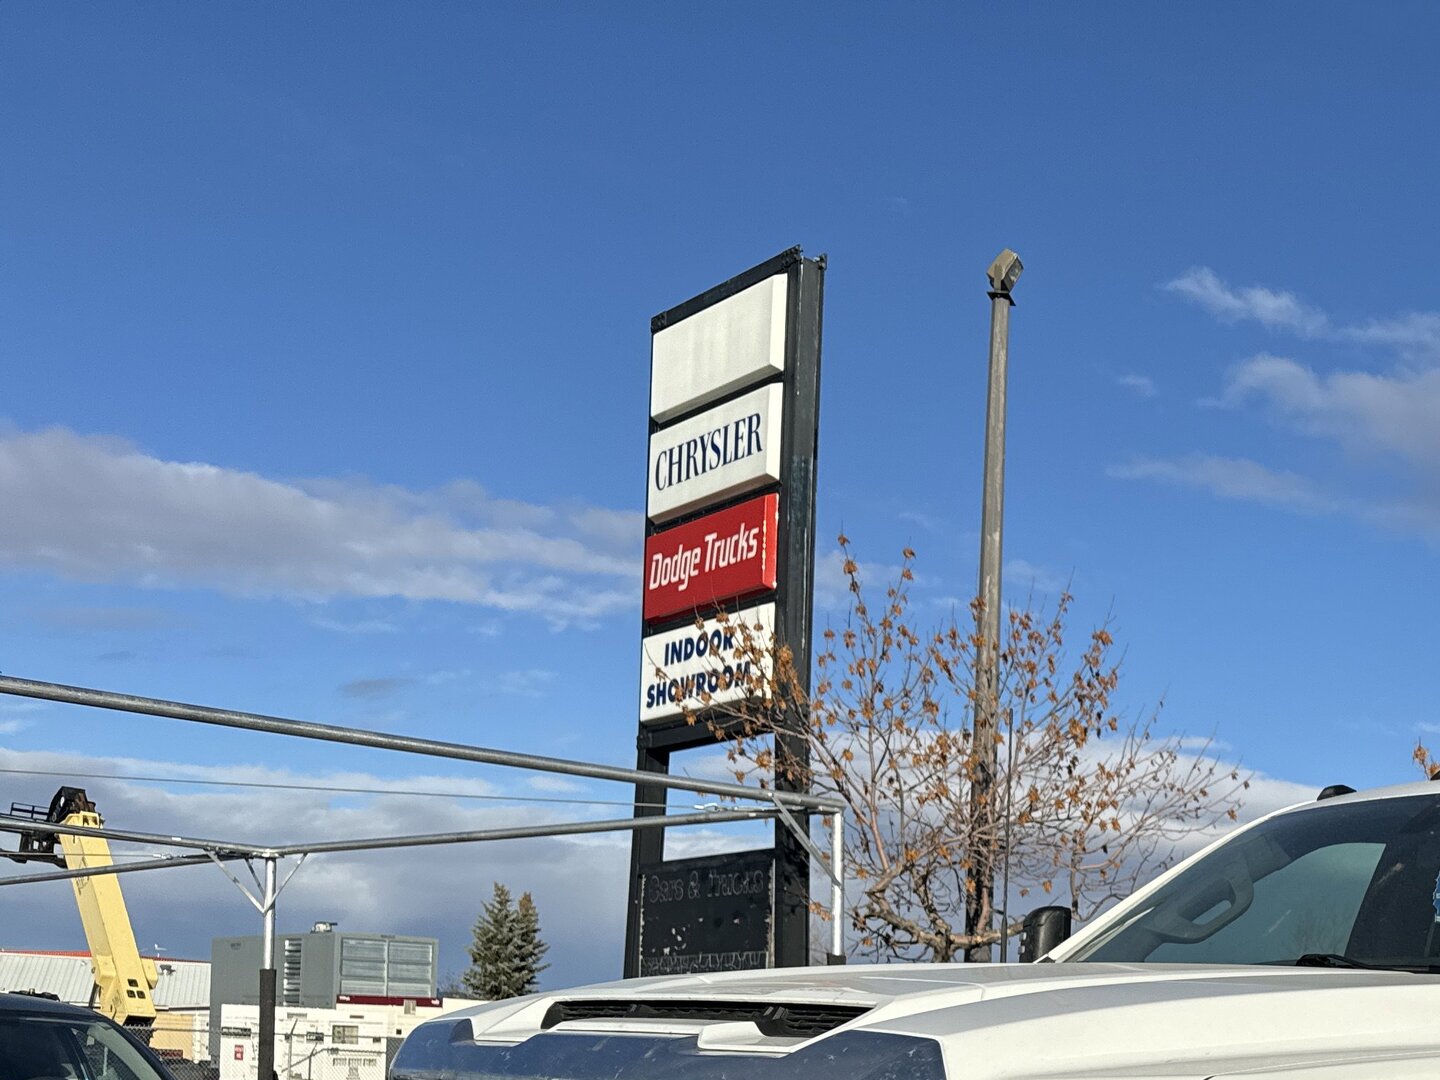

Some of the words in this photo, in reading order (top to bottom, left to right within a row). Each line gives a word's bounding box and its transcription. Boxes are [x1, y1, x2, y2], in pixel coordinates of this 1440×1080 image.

[655, 412, 763, 491] CHRYSLER
[649, 544, 701, 591] Dodge
[704, 522, 759, 572] Trucks
[664, 629, 734, 667] INDOOR
[646, 660, 751, 709] SHOWROOM
